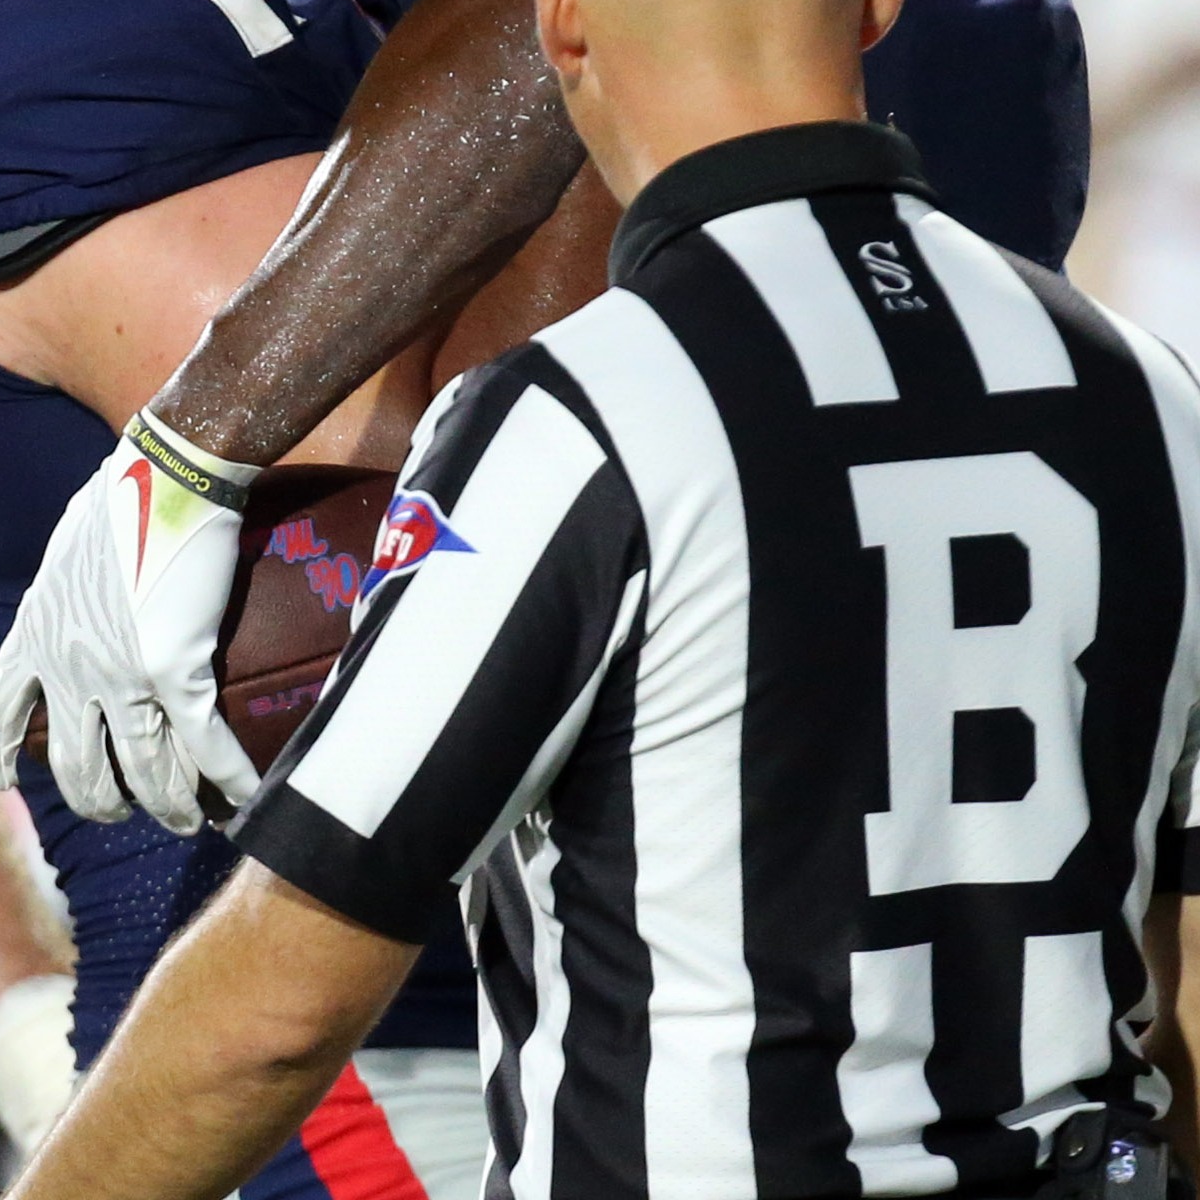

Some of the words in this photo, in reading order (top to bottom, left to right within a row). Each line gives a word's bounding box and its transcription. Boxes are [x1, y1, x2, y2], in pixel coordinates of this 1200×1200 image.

[138, 429, 212, 492] Community
[306, 552, 360, 613] Ole
[847, 450, 1101, 897] B
